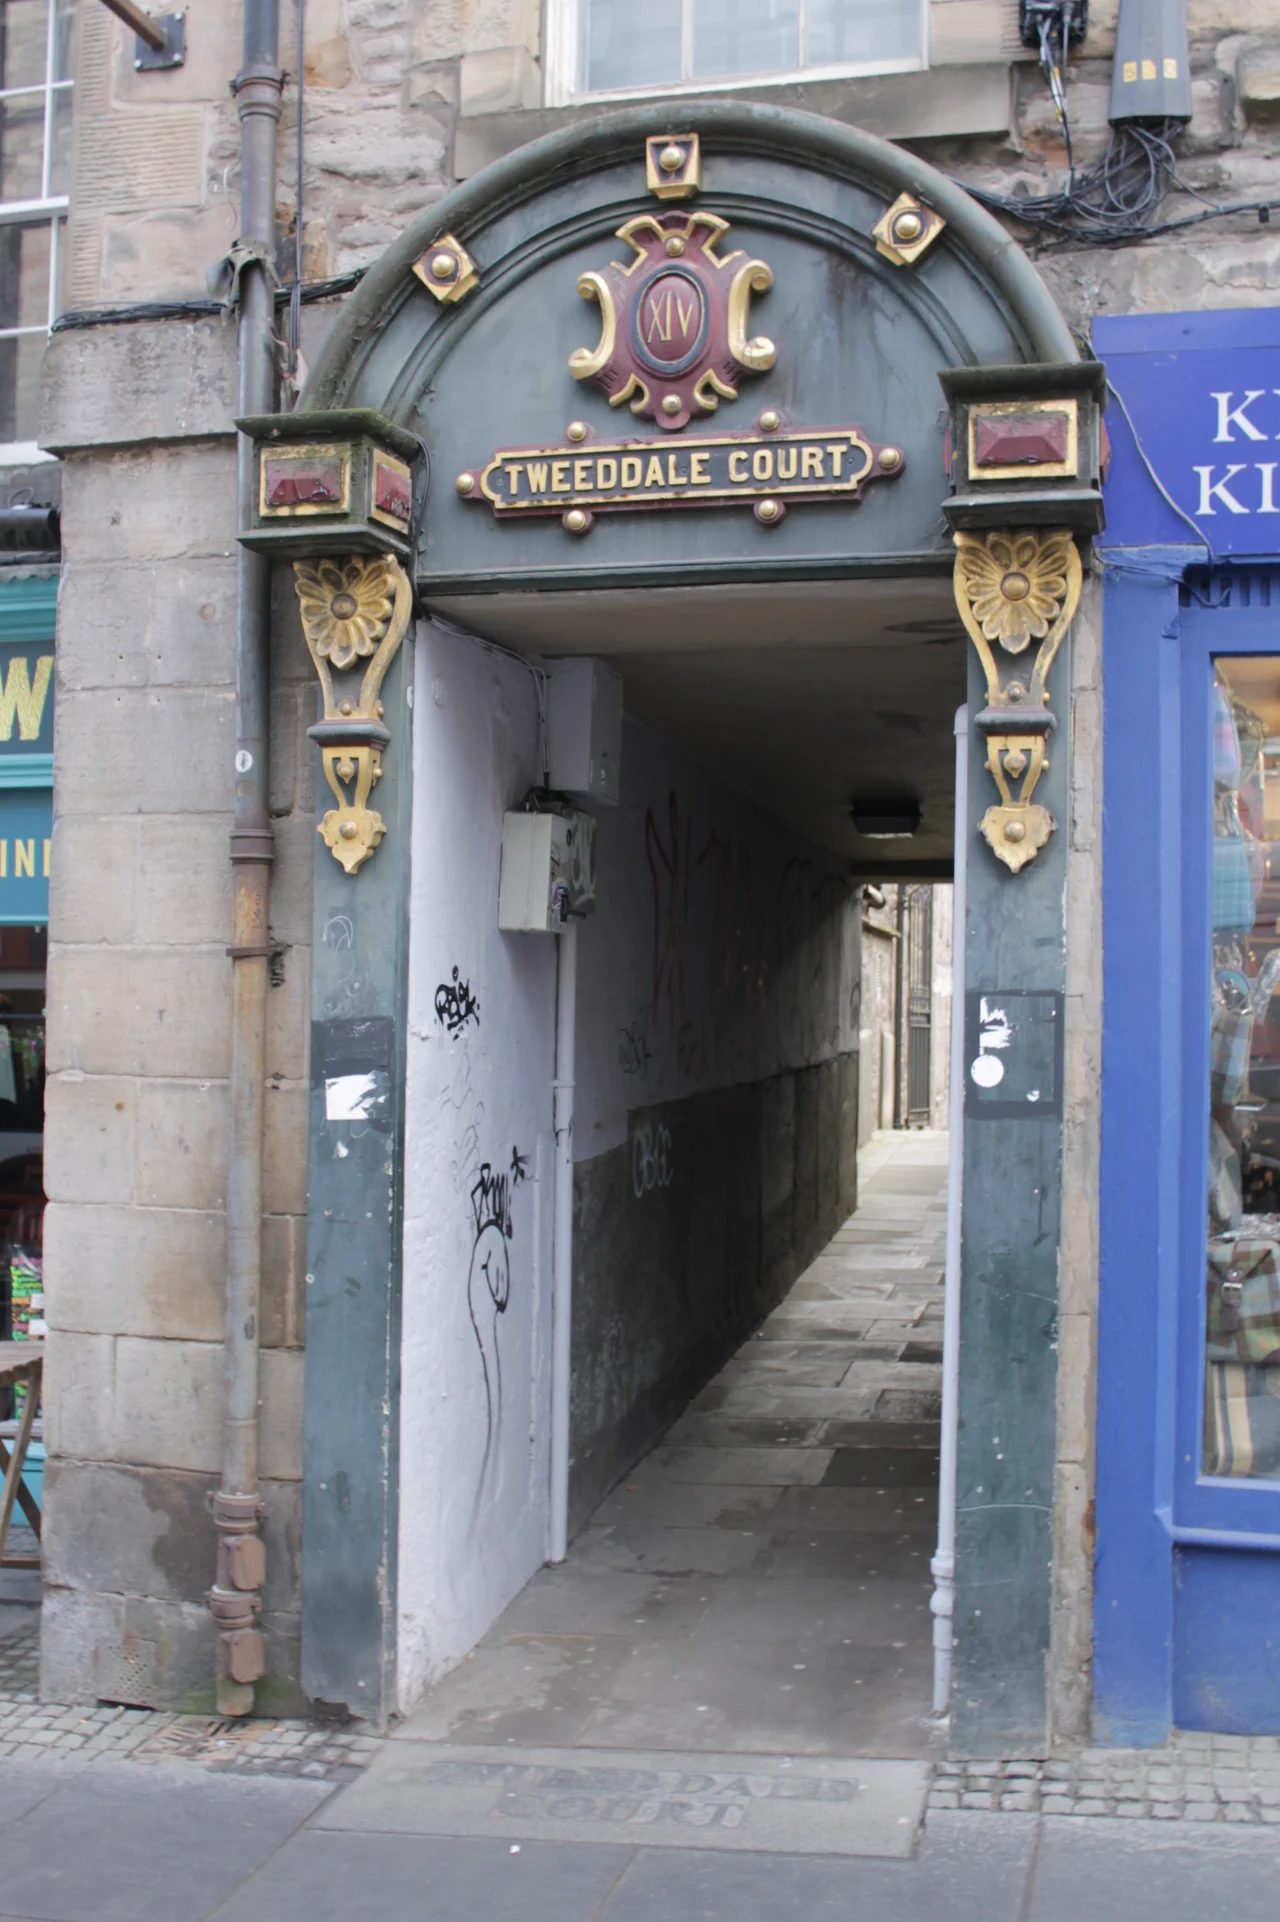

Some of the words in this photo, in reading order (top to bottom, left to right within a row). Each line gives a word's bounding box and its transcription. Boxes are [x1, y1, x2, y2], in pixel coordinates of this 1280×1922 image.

[647, 290, 695, 343] XIV
[1210, 389, 1280, 442] K
[504, 453, 711, 496] TWEEDDALE
[728, 444, 849, 483] COURT
